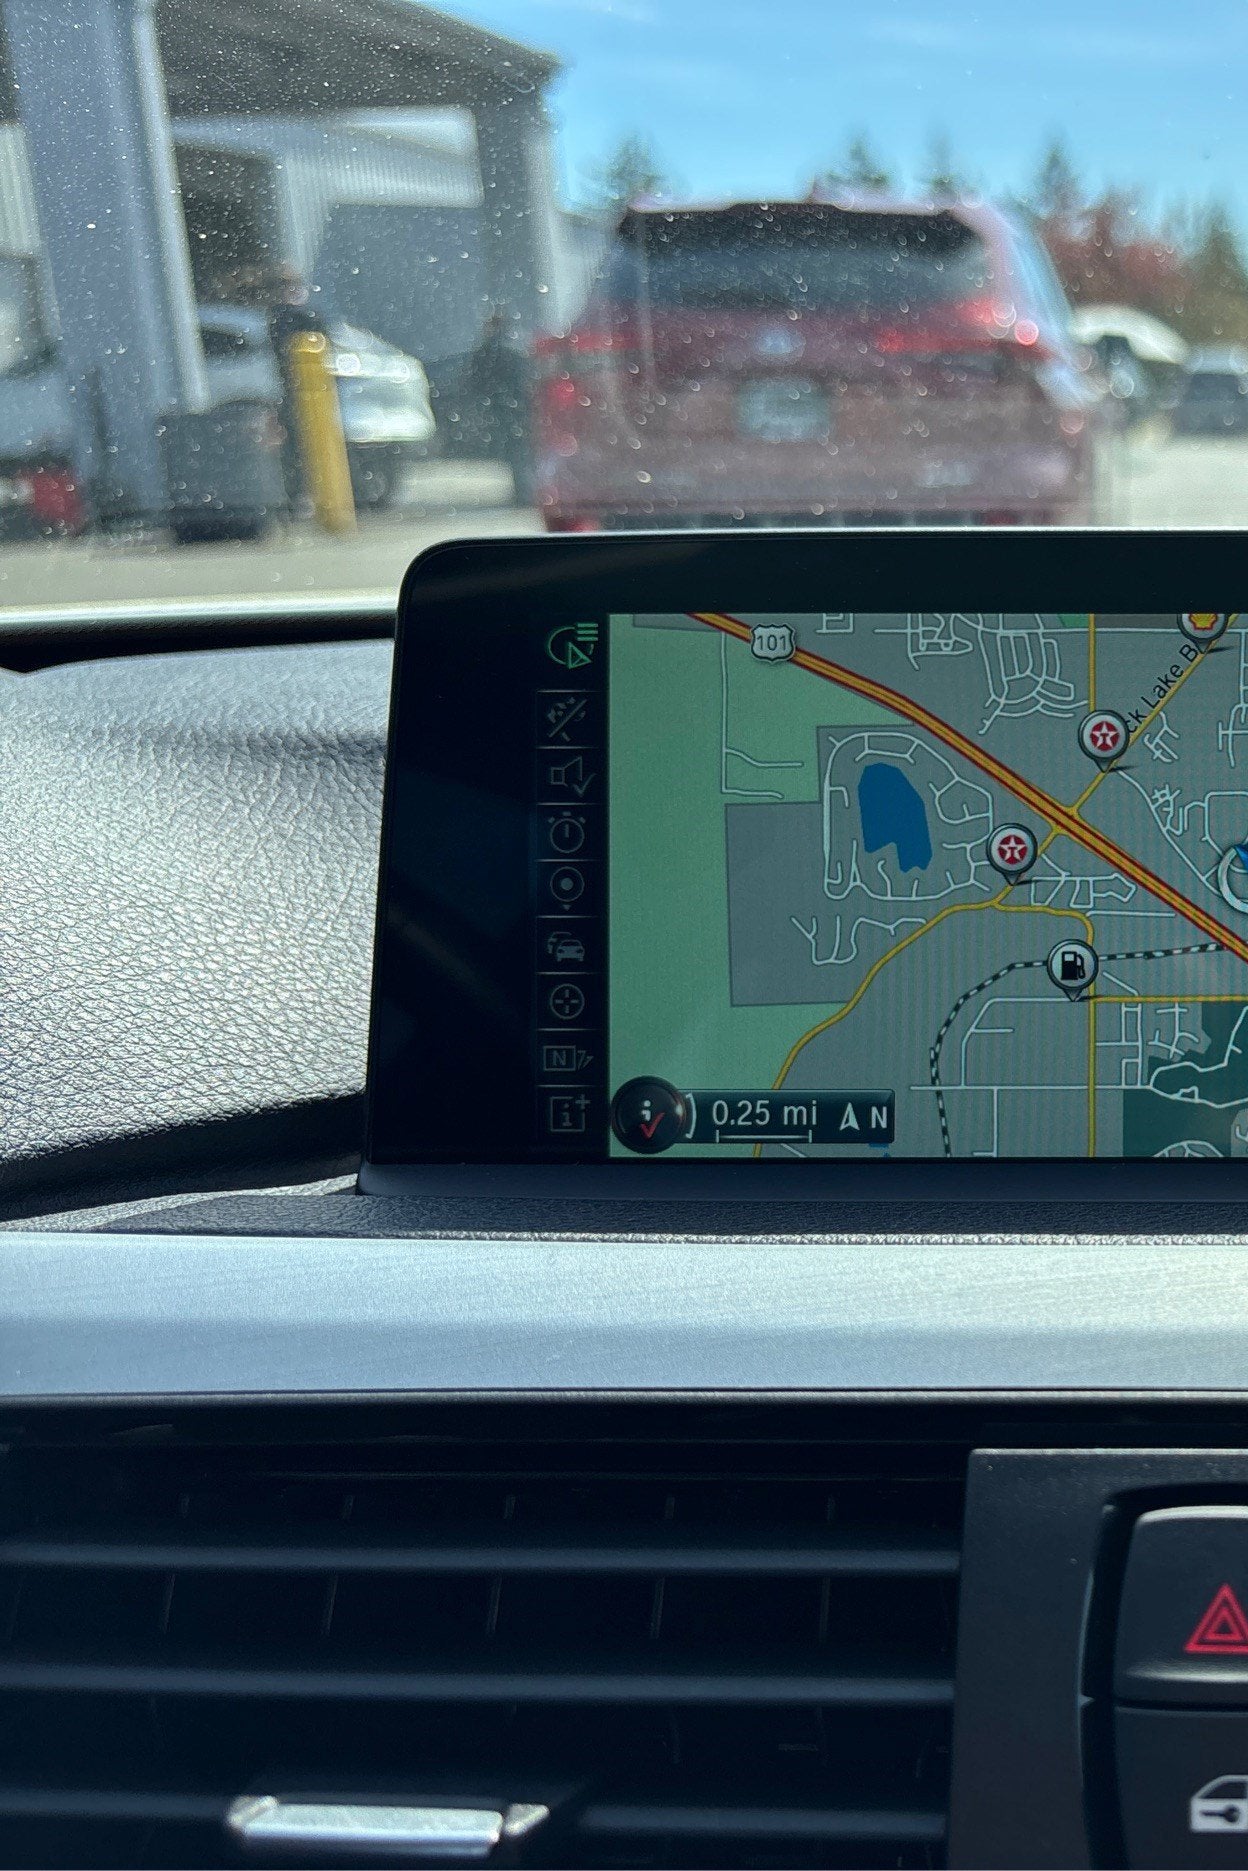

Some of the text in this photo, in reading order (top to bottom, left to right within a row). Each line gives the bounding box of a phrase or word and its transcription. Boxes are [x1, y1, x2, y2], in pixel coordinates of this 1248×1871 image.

[755, 634, 789, 652] 101
[1141, 664, 1184, 709] Lake
[711, 1099, 818, 1126] 0.25 mi
[870, 1106, 888, 1129] N
